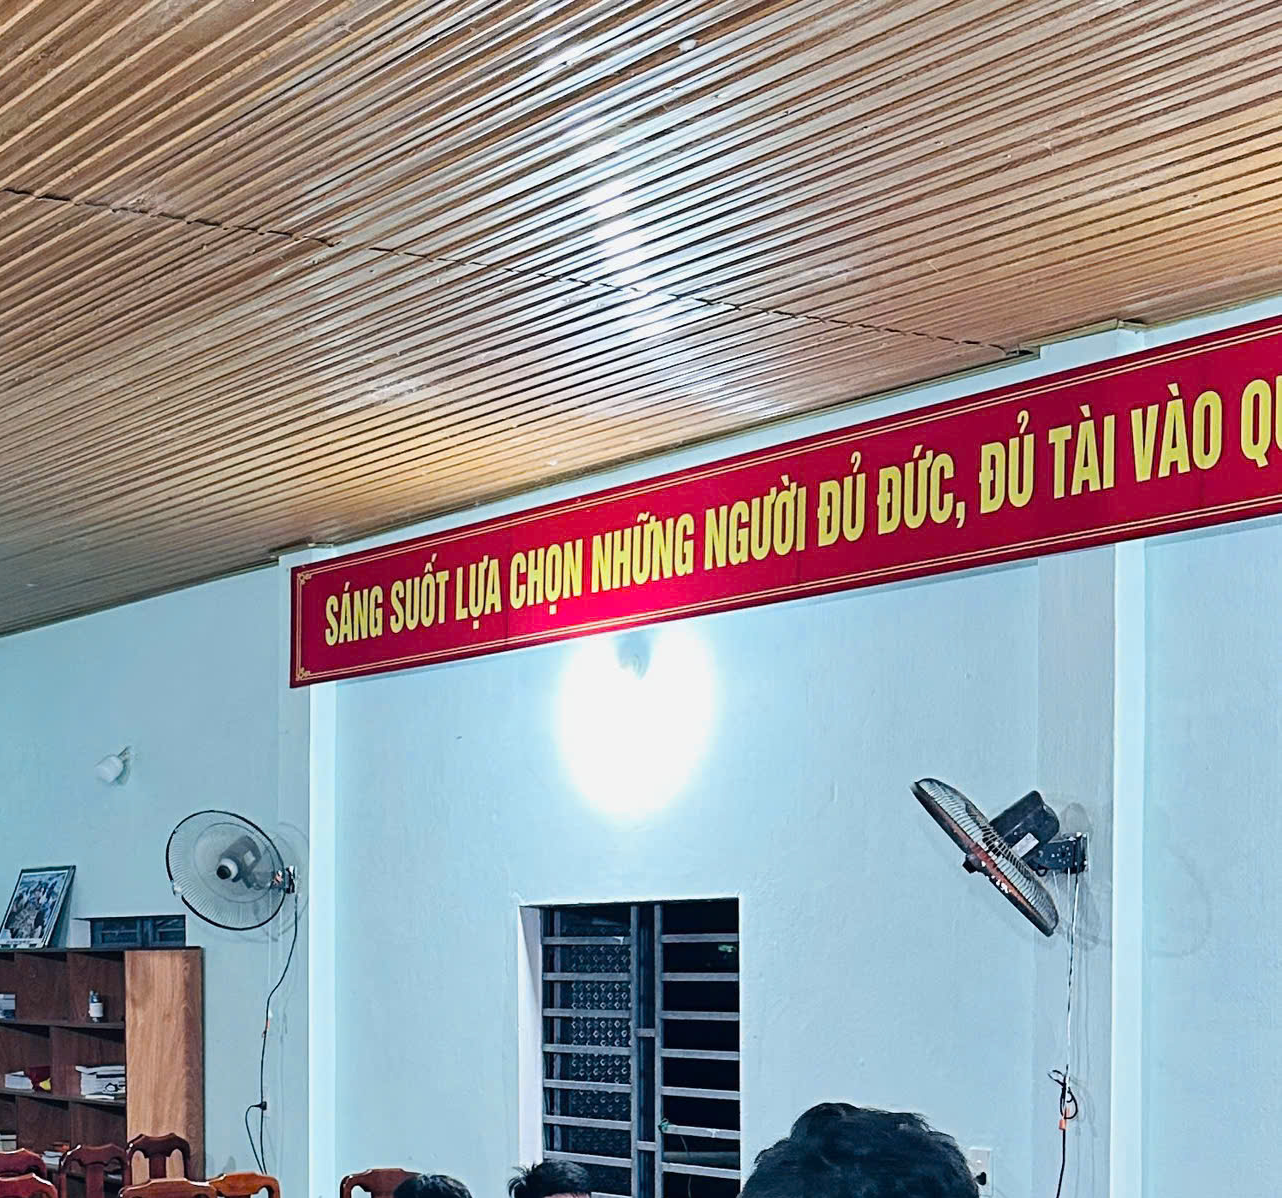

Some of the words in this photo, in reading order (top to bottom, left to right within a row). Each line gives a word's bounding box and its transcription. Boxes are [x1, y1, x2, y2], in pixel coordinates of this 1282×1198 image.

[325, 581, 383, 646] SÁNG
[390, 553, 449, 634] SUỐT
[455, 554, 502, 630] LỰA
[510, 538, 583, 615] CHỌN
[591, 511, 695, 594] NHỮNG
[704, 474, 806, 571] NGƯỜI
[817, 451, 866, 547] ĐỦ
[877, 444, 966, 535] ĐỨC,
[979, 410, 1034, 514] ĐỦ
[1048, 404, 1115, 500] TÀI
[1130, 382, 1223, 483] VÀO
[1241, 374, 1282, 468] Q
